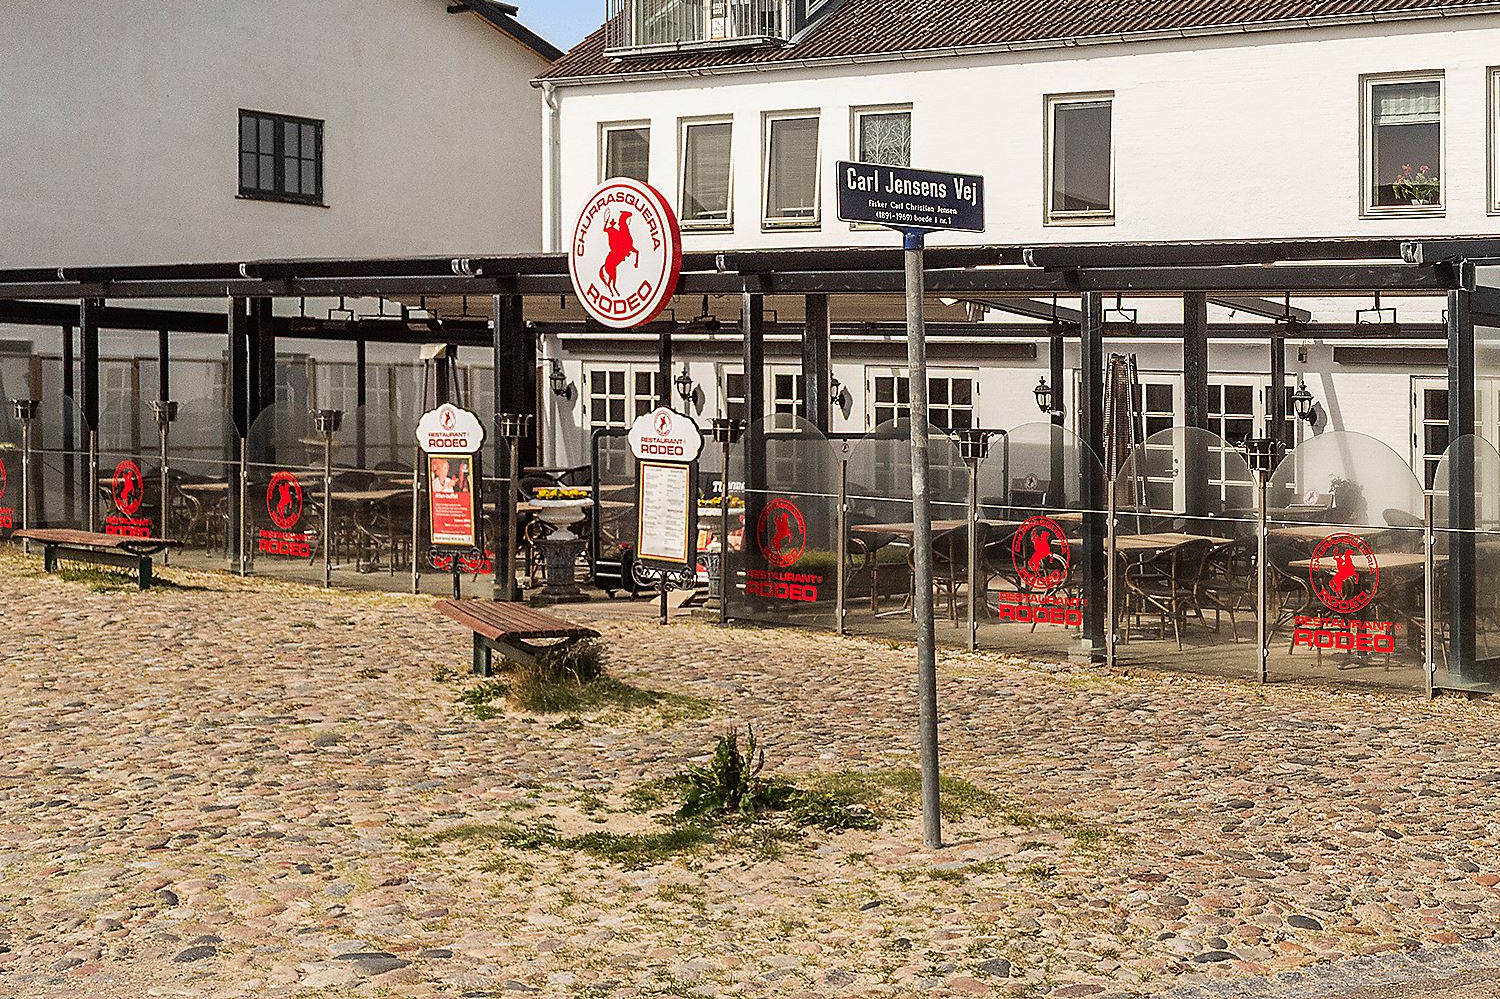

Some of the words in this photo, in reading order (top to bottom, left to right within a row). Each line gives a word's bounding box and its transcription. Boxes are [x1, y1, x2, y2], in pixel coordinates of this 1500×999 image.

[846, 167, 879, 192] Carl
[885, 171, 947, 198] Jensens
[953, 177, 977, 206] Vej
[868, 199, 888, 209] Fisker
[890, 201, 904, 210] Carl
[905, 202, 935, 213] Christian
[936, 205, 959, 215] Jensen
[577, 191, 661, 257] CHURRASQUERIA
[586, 280, 653, 314] RODEO
[429, 439, 468, 448] RODEO
[640, 437, 683, 445] RESTAURANT
[641, 444, 684, 456] RODEO
[259, 539, 311, 557] RODEO
[746, 569, 818, 583] RESTAURANT
[746, 580, 818, 602] RODEO
[999, 592, 1083, 606] RESTAURANT
[1320, 588, 1369, 609] RODEO
[999, 603, 1083, 627] RODEO
[1294, 615, 1393, 632] RESTAURANT
[1293, 628, 1395, 653] RODEO
